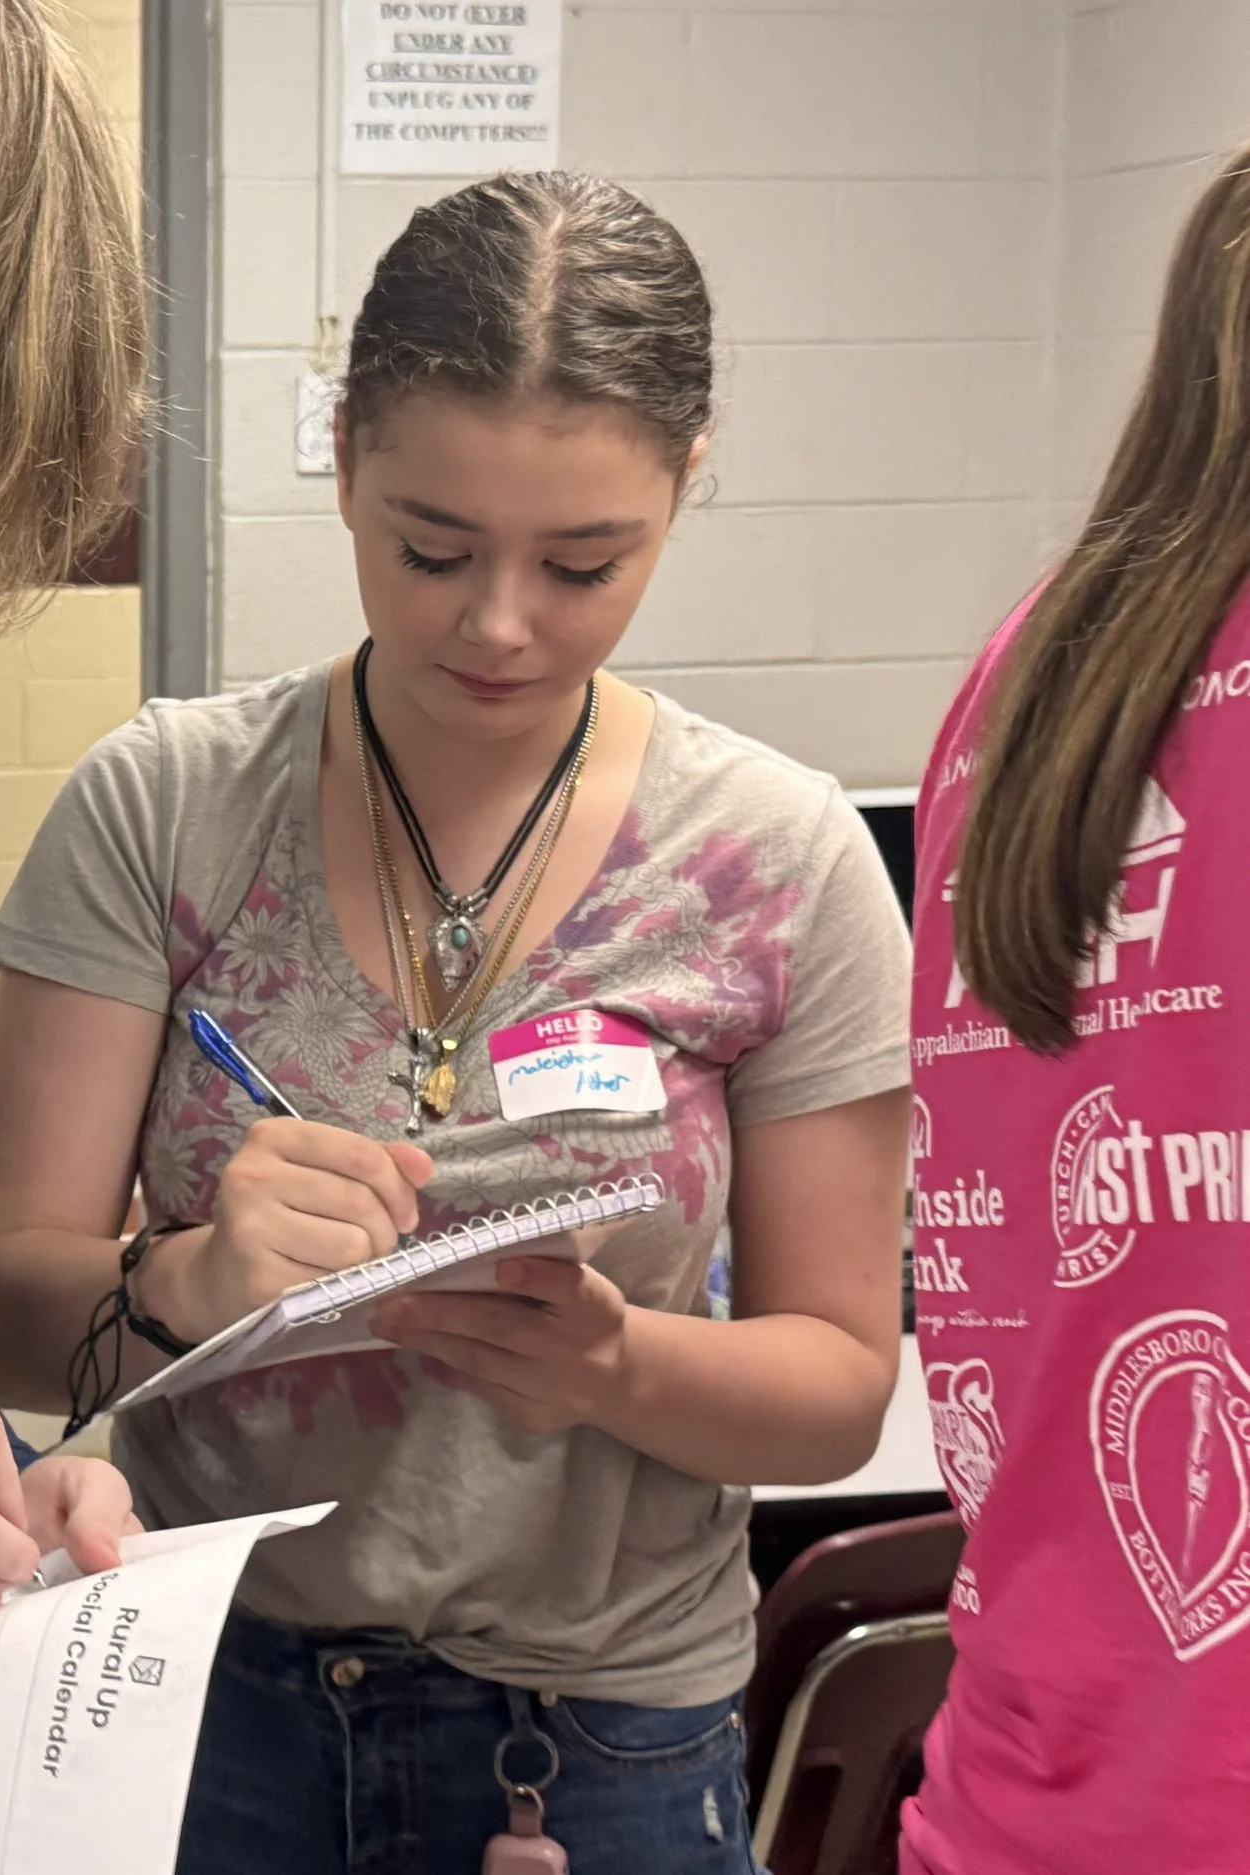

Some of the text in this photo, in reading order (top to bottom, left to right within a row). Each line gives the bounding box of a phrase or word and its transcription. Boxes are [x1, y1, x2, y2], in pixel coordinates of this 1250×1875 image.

[381, 3, 412, 22] DO
[416, 4, 459, 22] NOT
[393, 31, 515, 55] UNDER ANY
[368, 90, 536, 111] UNPLUG ANY OF
[354, 122, 396, 142] THE
[913, 1168, 1005, 1228] hside
[1104, 1328, 1211, 1457] MIDDLESBORO
[42, 1572, 120, 1780] Social Calendar
[85, 1606, 140, 1729] Rural Up
